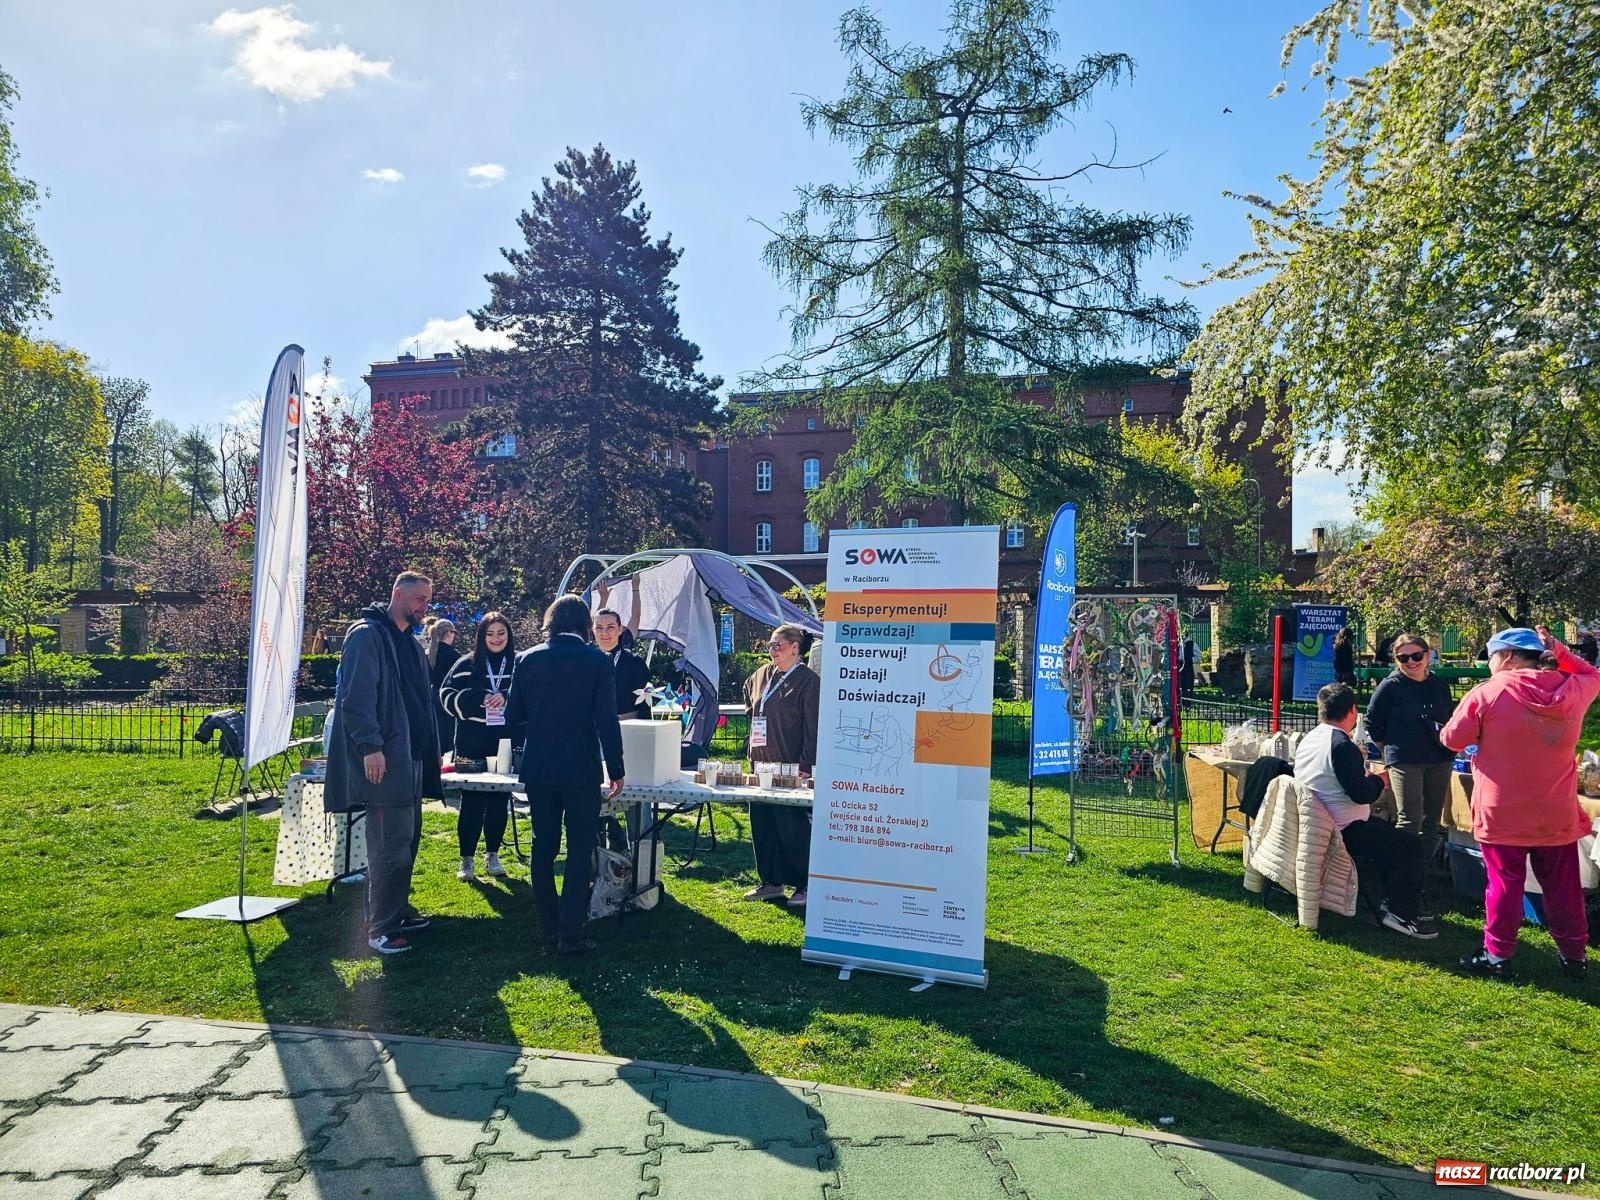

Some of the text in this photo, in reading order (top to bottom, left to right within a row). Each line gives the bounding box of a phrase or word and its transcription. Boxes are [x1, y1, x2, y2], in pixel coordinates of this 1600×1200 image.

[845, 548, 908, 565] SOWA
[853, 575, 890, 583] Raciborzu
[843, 603, 947, 618] Eksperymentuj!
[1300, 609, 1342, 617] WARSZTAT
[841, 624, 915, 640] Sprawdzaj!
[840, 646, 907, 662] Obserwuj!
[1039, 643, 1063, 655] WARSZ
[1038, 655, 1064, 670] TERA
[839, 667, 887, 683] Działaj!
[838, 688, 926, 707] Doświadczaj!
[831, 780, 905, 795] SOWA Racibórz
[841, 801, 867, 811] Ocicka
[868, 803, 879, 811] 52
[830, 811, 929, 828] (wejście od ul. Żorskiej 2)
[829, 822, 891, 835] tel.: 798 386 894
[828, 834, 953, 854] e-mail: biuro@sowa-raciborz.pl
